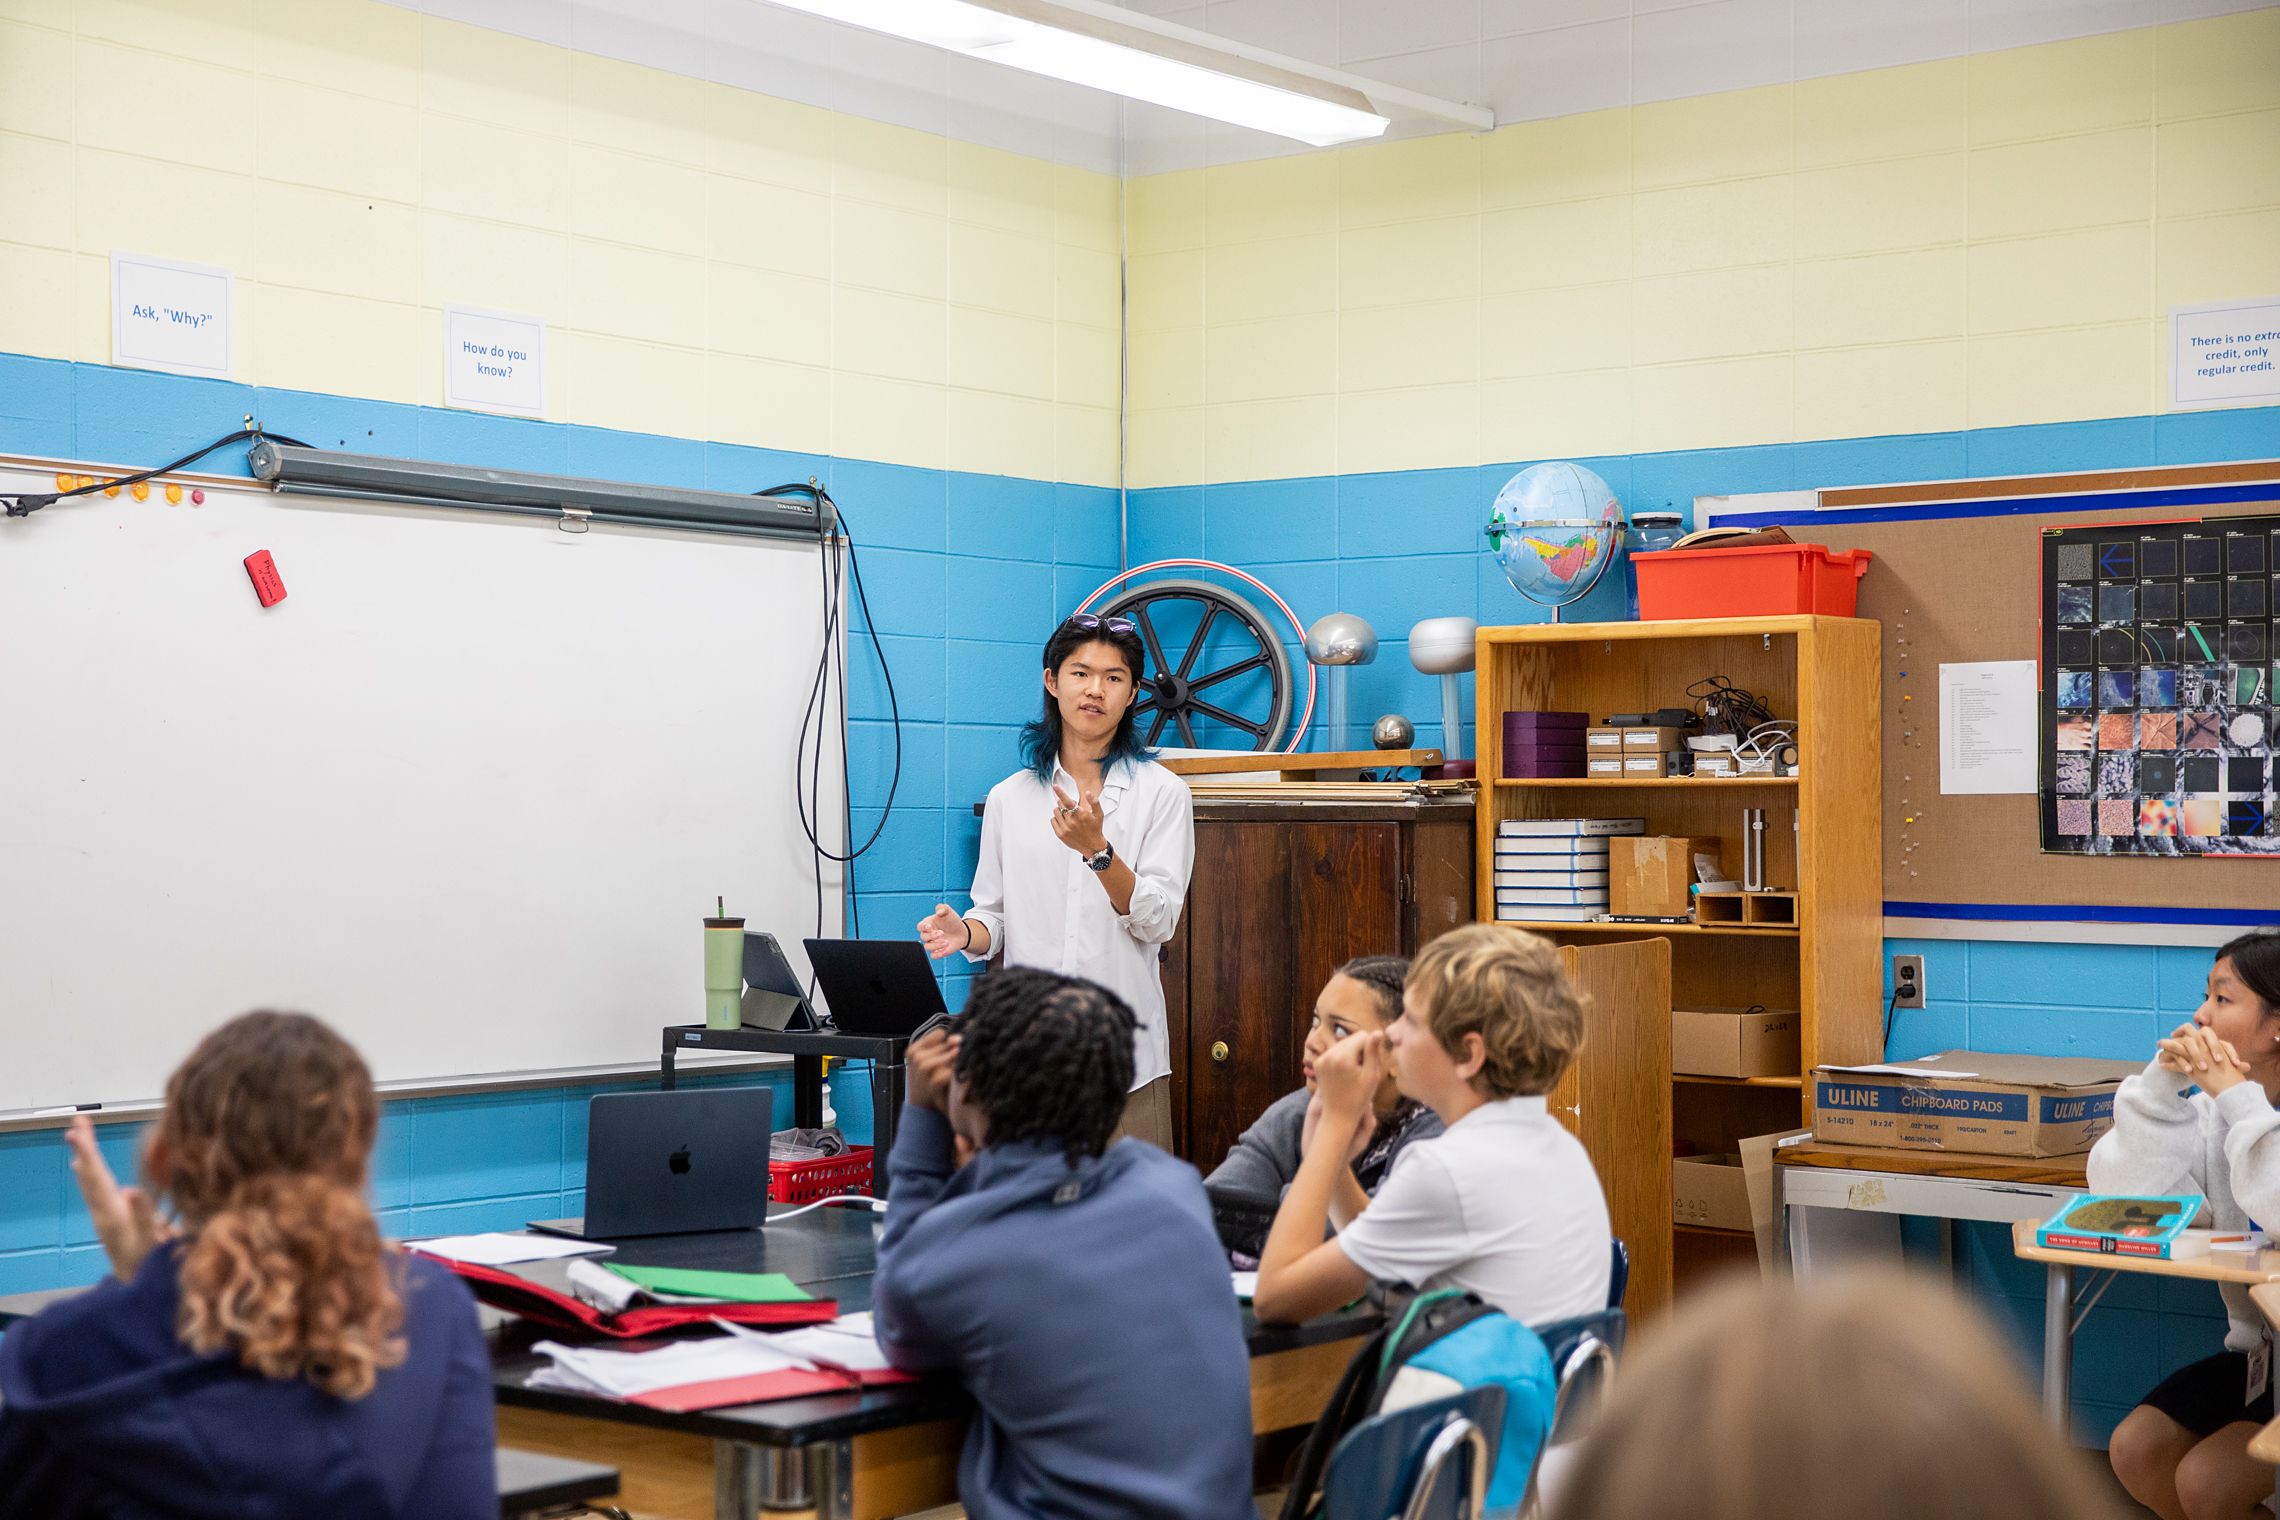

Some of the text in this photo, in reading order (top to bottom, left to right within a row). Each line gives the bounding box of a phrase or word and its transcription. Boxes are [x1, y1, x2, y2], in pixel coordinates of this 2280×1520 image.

[132, 304, 213, 328] Ask, "Why?"
[2191, 336, 2222, 347] There
[2225, 334, 2234, 344] is
[2237, 334, 2251, 343] no
[463, 341, 527, 363] How do you
[2206, 347, 2268, 360] credit, only
[477, 363, 513, 379] know?
[2197, 361, 2276, 377] regular credit.
[1828, 1088, 2004, 1113] ULINE CHIPBOARD PADS
[2053, 1101, 2087, 1120] ULINE
